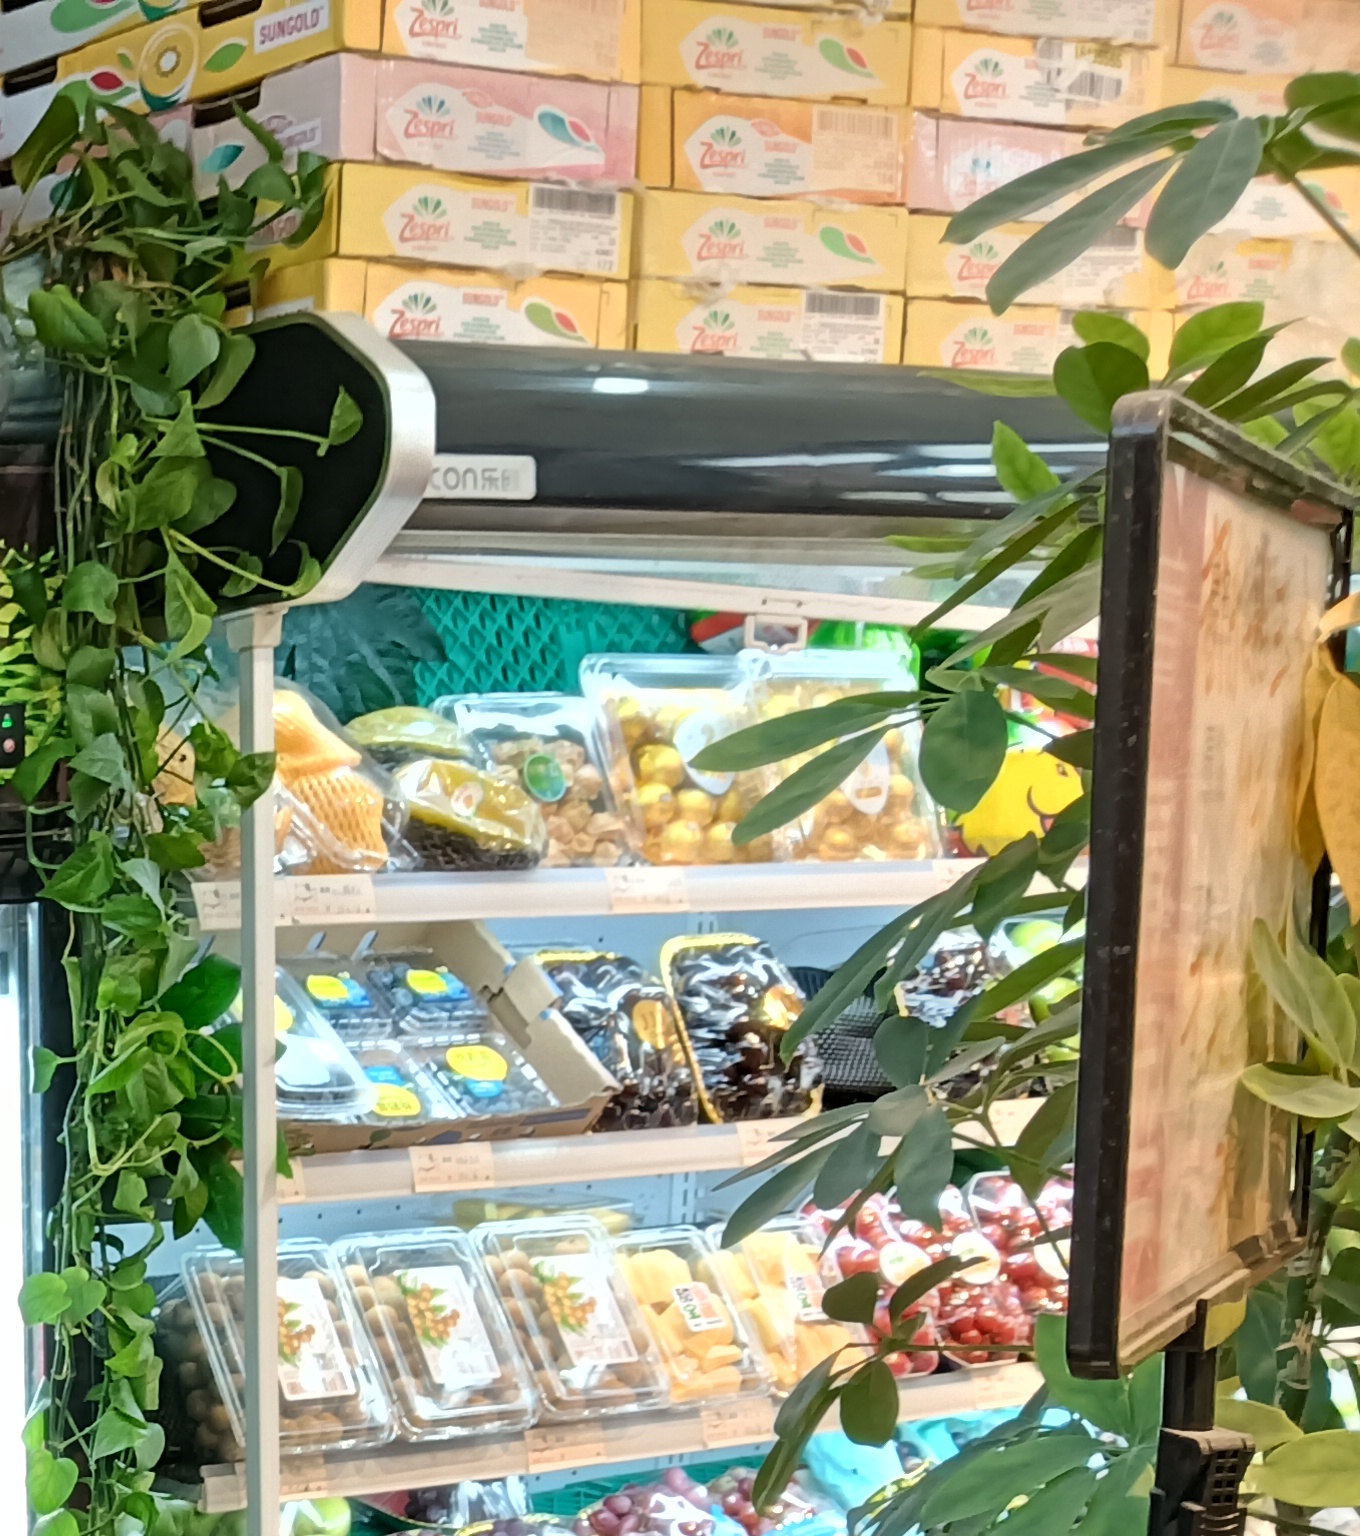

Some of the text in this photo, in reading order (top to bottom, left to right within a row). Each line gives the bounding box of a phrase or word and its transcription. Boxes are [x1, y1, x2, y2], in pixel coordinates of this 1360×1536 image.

[258, 9, 321, 45] SUNGOLD
[408, 7, 460, 38] Zespri
[695, 41, 746, 70] Zespri
[403, 109, 457, 139] Zespri
[699, 141, 746, 170] Zespri
[398, 213, 453, 243] Zespri
[696, 233, 748, 262] Zespri
[388, 309, 445, 340] Zespri
[690, 326, 741, 353] Zespri
